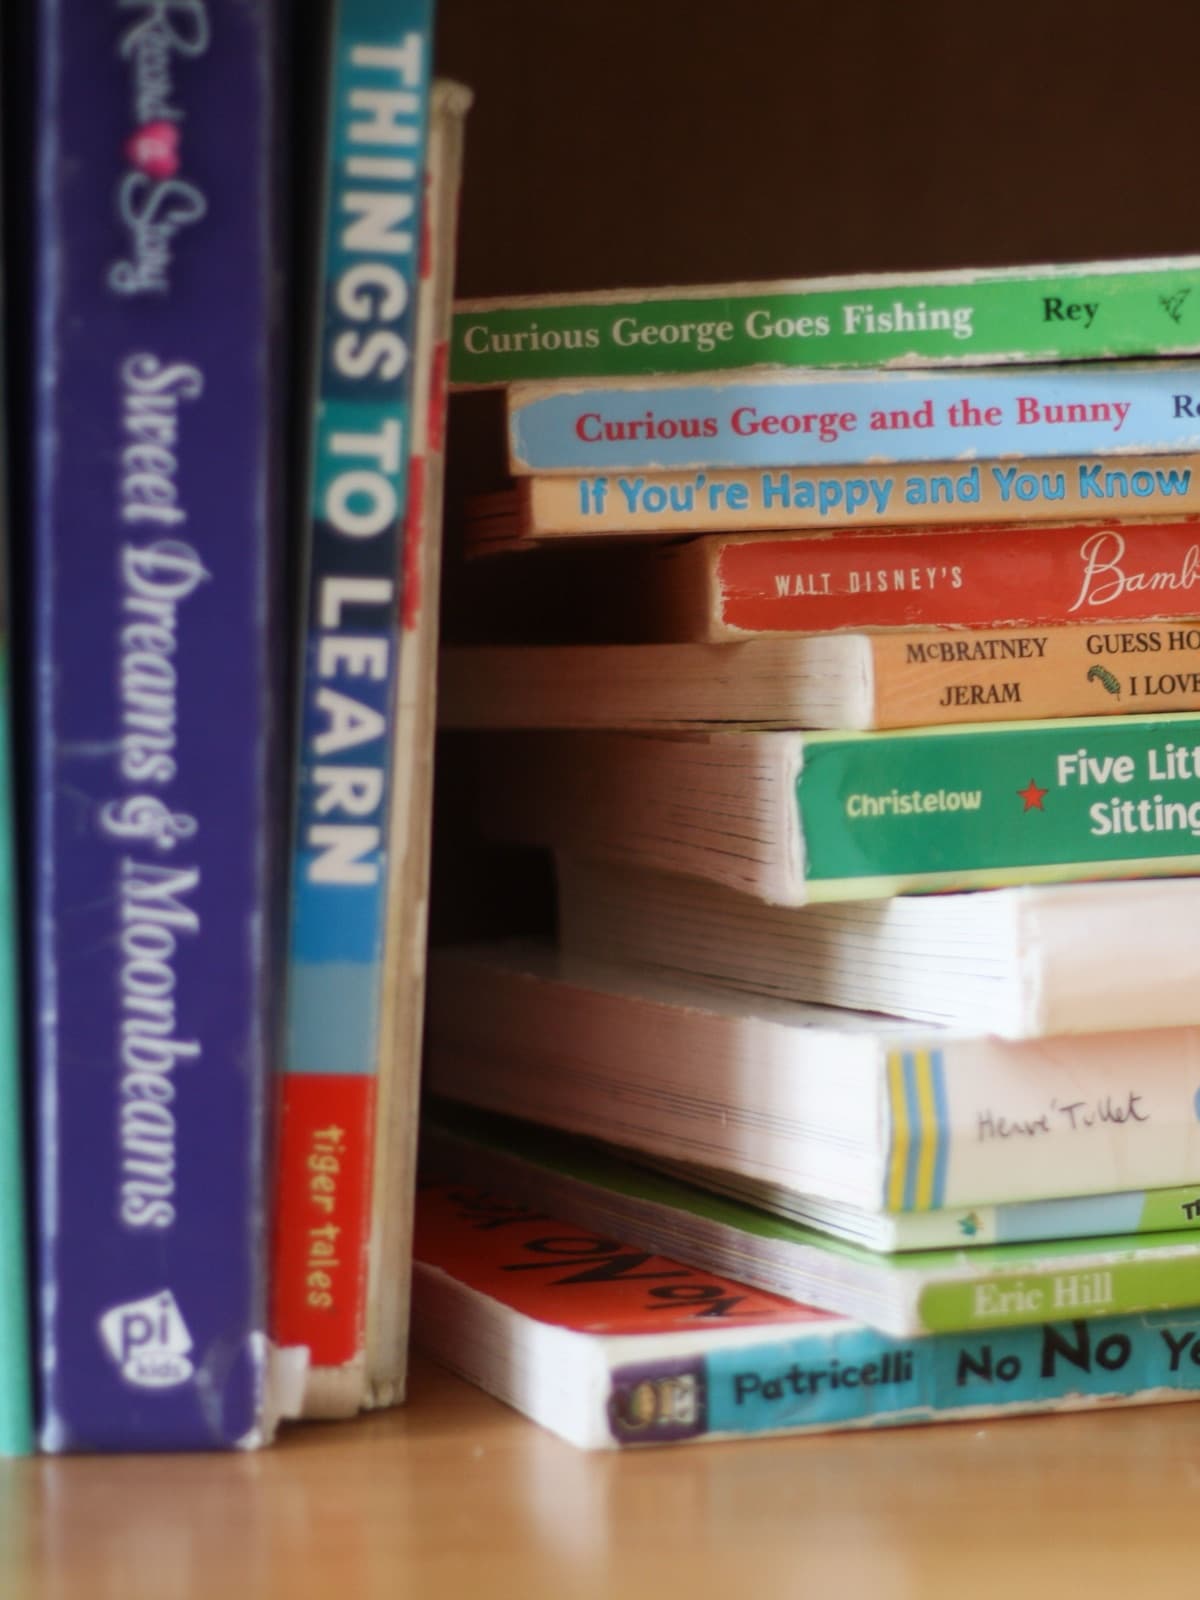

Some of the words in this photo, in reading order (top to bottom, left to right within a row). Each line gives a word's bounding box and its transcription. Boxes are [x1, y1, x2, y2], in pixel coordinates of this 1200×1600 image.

[109, 172, 207, 295] Story
[334, 33, 425, 382] THINGS
[463, 323, 600, 355] Curious
[612, 317, 735, 353] George
[745, 309, 831, 339] Goes
[843, 300, 975, 339] Fishing
[1042, 297, 1100, 328] Rey
[121, 352, 204, 525] Sweet
[575, 411, 718, 443] Curious
[730, 406, 858, 443] George
[869, 400, 936, 431] and
[947, 397, 1002, 429] the
[1015, 397, 1132, 432] Bunny
[324, 417, 402, 538] TO
[577, 476, 609, 515] If
[618, 473, 749, 514] You're
[761, 473, 894, 515] Happy
[905, 465, 981, 505] and
[991, 465, 1066, 502] You
[1078, 463, 1191, 499] Know
[774, 573, 831, 598] WALT
[849, 566, 963, 594] DISNEY'S
[121, 538, 213, 783] Dreams
[1085, 631, 1162, 655] GUESS
[938, 682, 1022, 708] JERAM
[1128, 676, 1139, 697] I
[307, 577, 395, 885] LEARN
[1056, 749, 1135, 787] Five
[845, 789, 982, 819] Christelow
[121, 857, 201, 1228] Moonbeams
[307, 1123, 345, 1214] tiger
[306, 1222, 341, 1310] tales
[972, 1283, 1045, 1318] Eric
[1052, 1271, 1114, 1308] Hill
[122, 1299, 169, 1362] pi
[955, 1344, 1022, 1387] No
[1040, 1318, 1132, 1379] No
[733, 1351, 914, 1405] Patricelli
